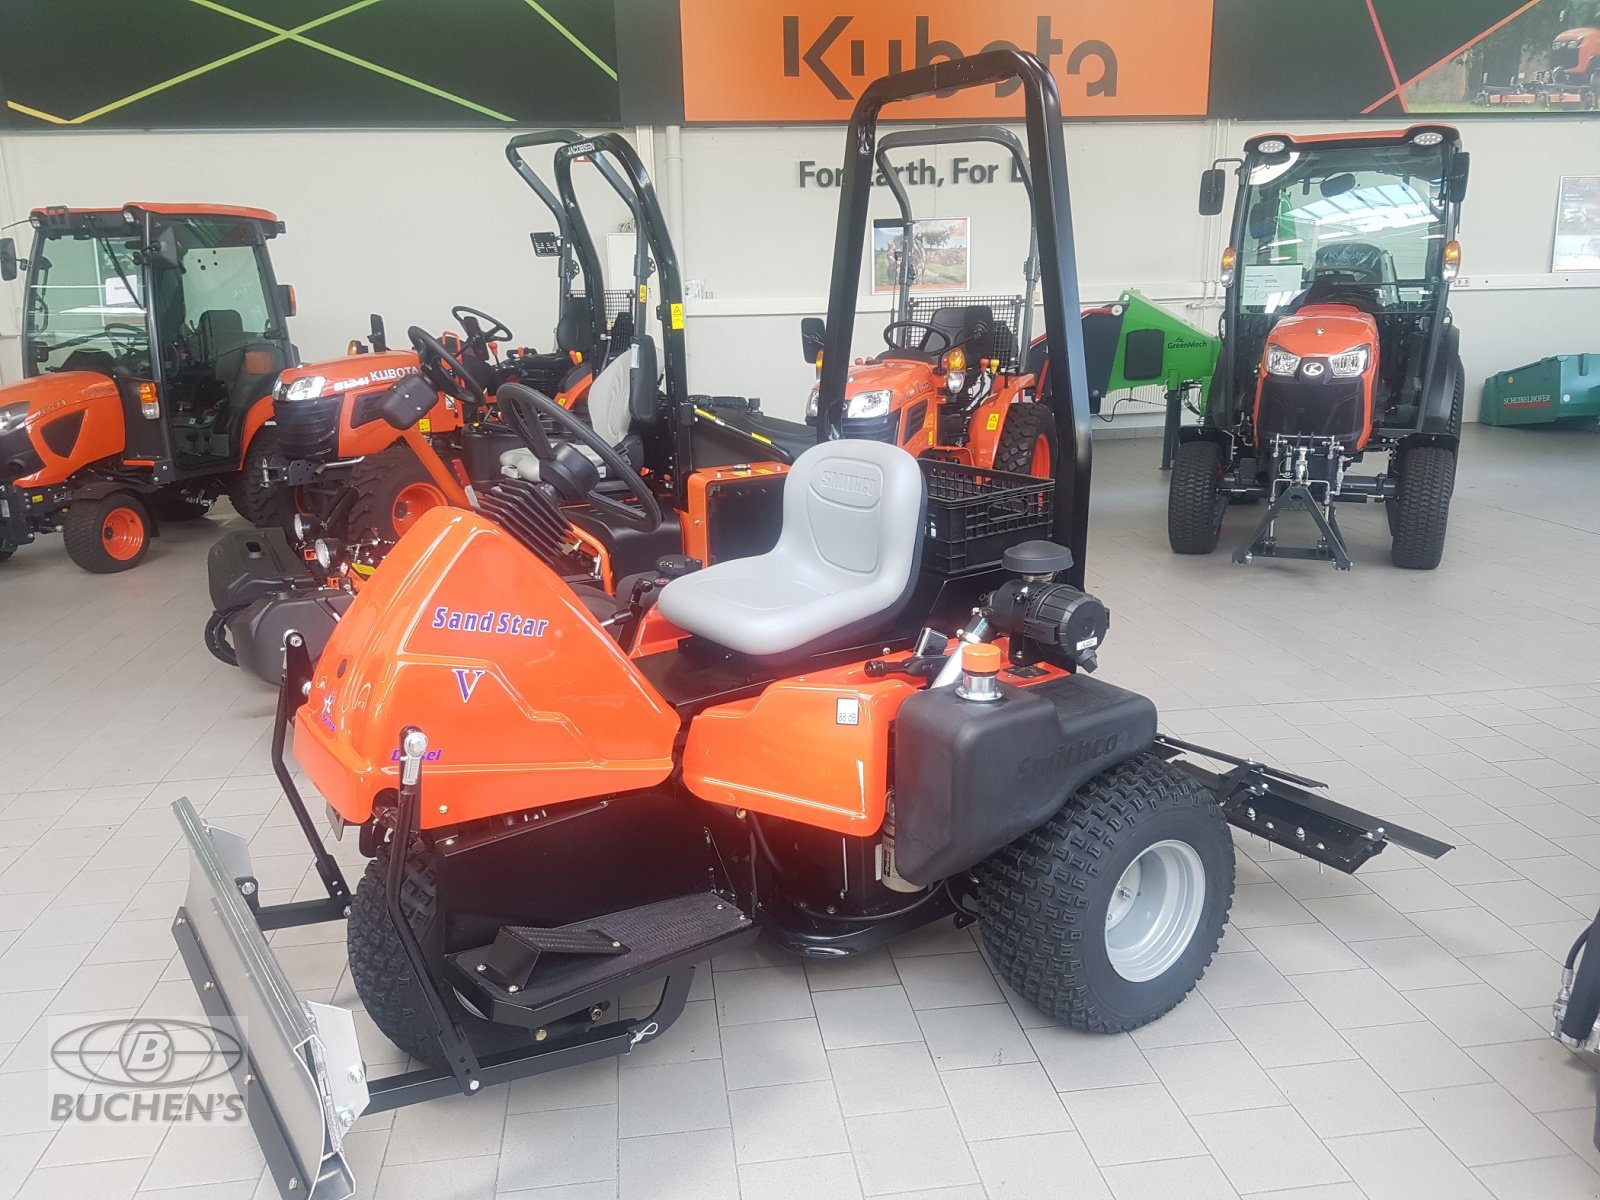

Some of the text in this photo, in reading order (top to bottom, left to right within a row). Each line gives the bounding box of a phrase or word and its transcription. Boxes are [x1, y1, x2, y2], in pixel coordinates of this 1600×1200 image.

[567, 142, 595, 155] JACOBSEN
[869, 158, 944, 187] arth,
[953, 157, 999, 184] For
[1167, 340, 1208, 349] GreenMech
[369, 366, 418, 381] KUBOTA
[1503, 394, 1551, 404] SCHEIBELHOFER
[452, 668, 486, 703] V
[847, 713, 857, 722] dB
[390, 749, 442, 761] Del
